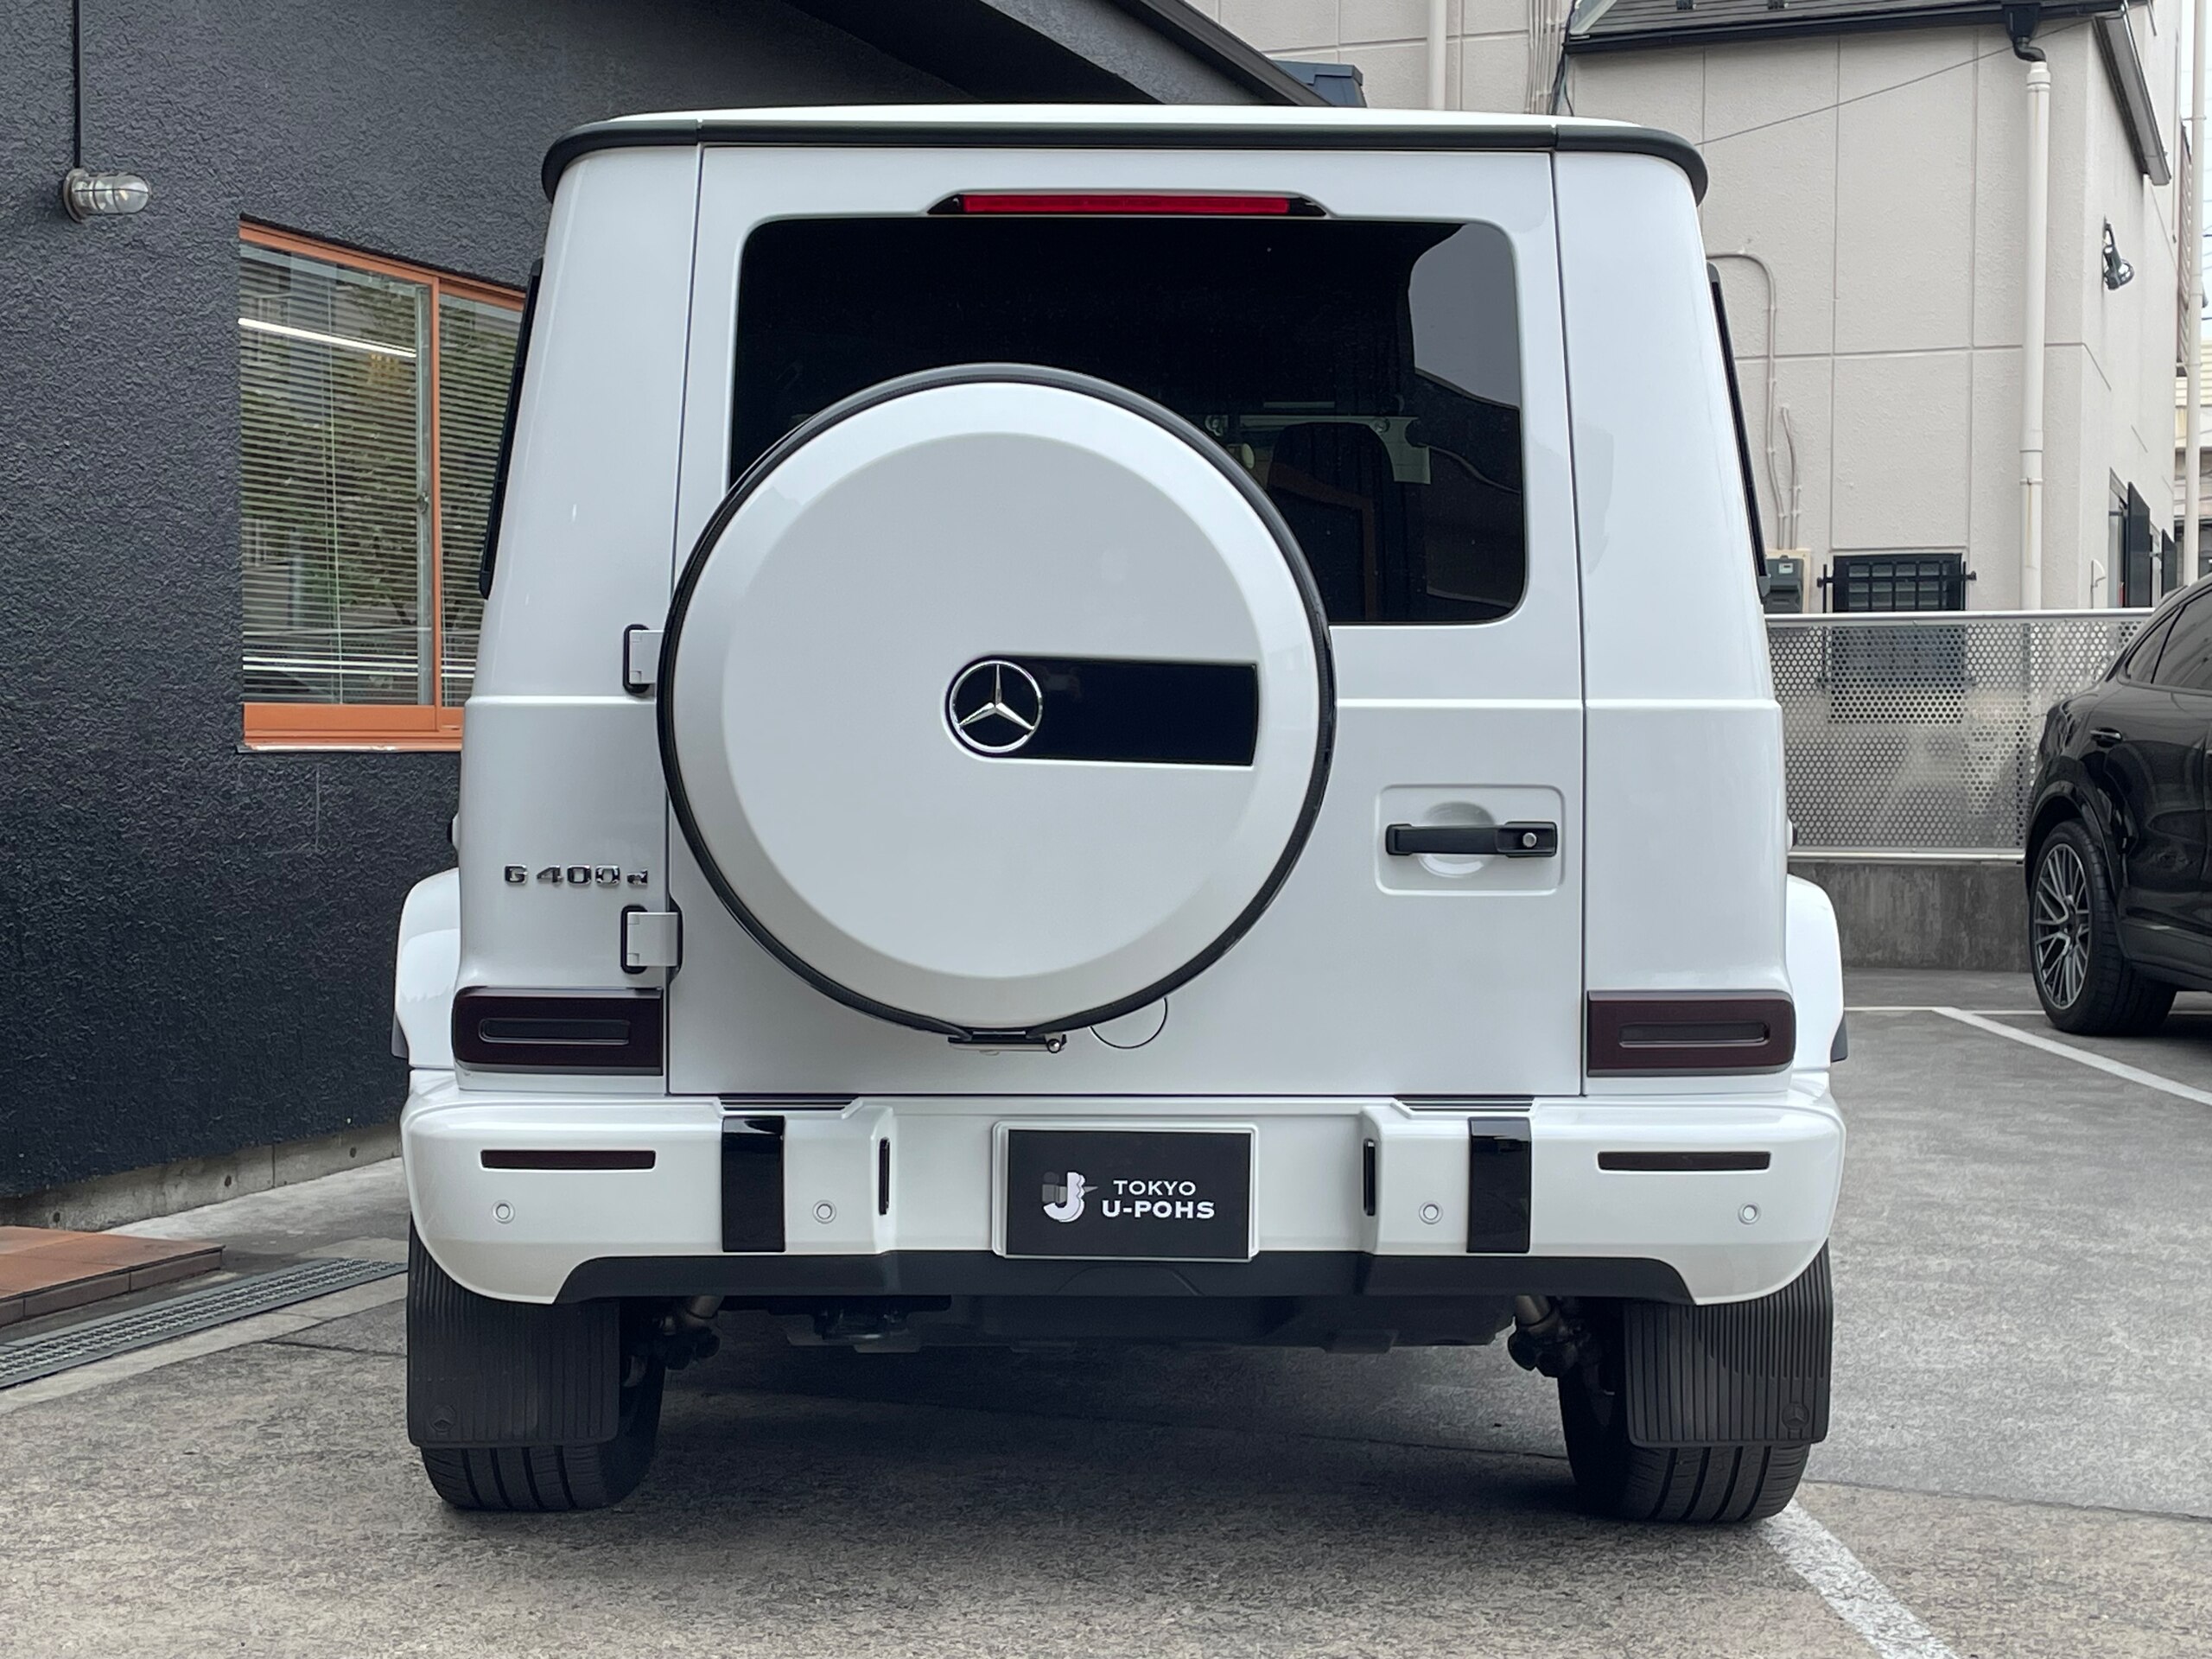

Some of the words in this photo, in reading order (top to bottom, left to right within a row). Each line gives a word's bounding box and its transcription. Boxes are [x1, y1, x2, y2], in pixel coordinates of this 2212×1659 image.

[504, 864, 528, 885] G
[536, 864, 620, 885] 400
[1113, 1179, 1197, 1196] TOKYO
[1102, 1199, 1215, 1219] U-POHS
